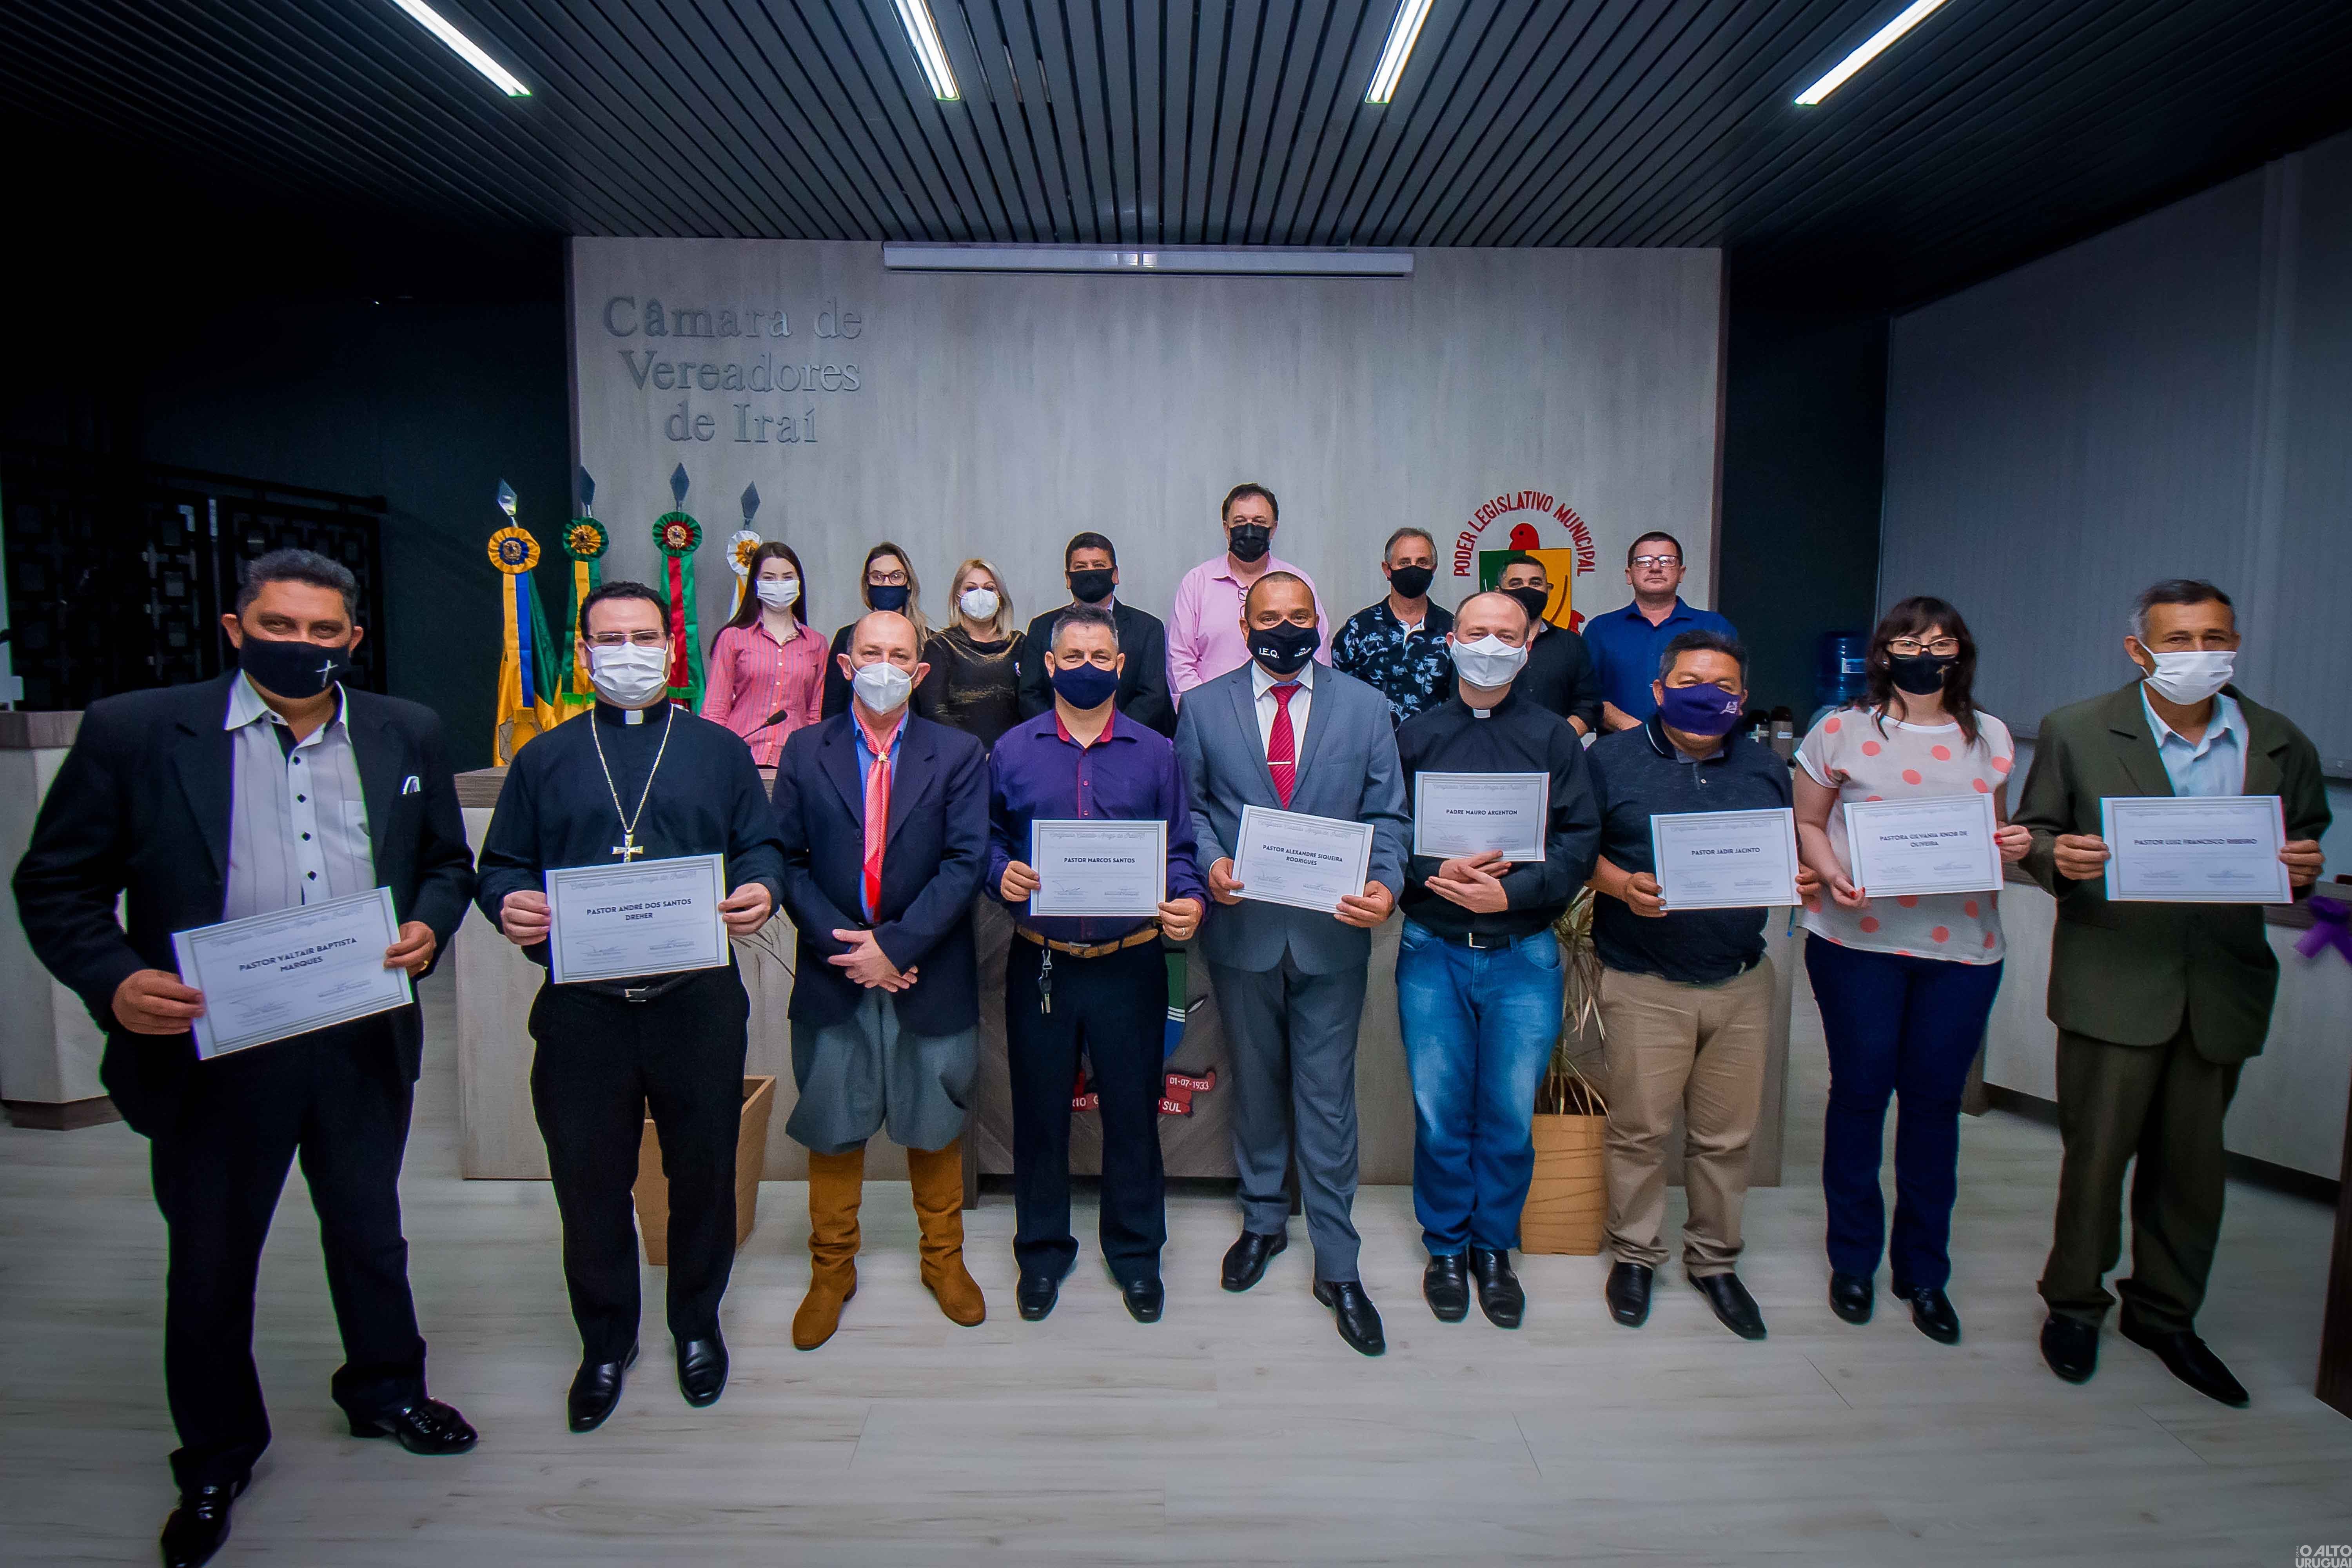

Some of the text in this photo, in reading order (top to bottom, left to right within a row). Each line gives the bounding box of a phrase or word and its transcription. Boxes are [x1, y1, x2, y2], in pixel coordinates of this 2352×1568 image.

[603, 296, 862, 339] Câmara de
[619, 350, 861, 392] Vereadores
[667, 400, 818, 443] de Iraí
[1454, 490, 1596, 577] PODER LEGISLATIVO MUNICIPAL
[1285, 849, 1317, 858] ALEXANDRE
[1318, 854, 1343, 862] SIQUEIRA
[1286, 856, 1317, 866] RODRIGUES
[587, 906, 617, 915] PASTOR
[619, 903, 643, 912] ANDRÉ
[663, 898, 691, 907] SANTOS
[625, 912, 653, 920] DREHER
[239, 937, 357, 971] PASTOR VALTAIR BAPTISTA
[280, 956, 323, 972] MARQUES
[1170, 1077, 1209, 1090] 01-07-1933
[1162, 1101, 1181, 1112] SUL
